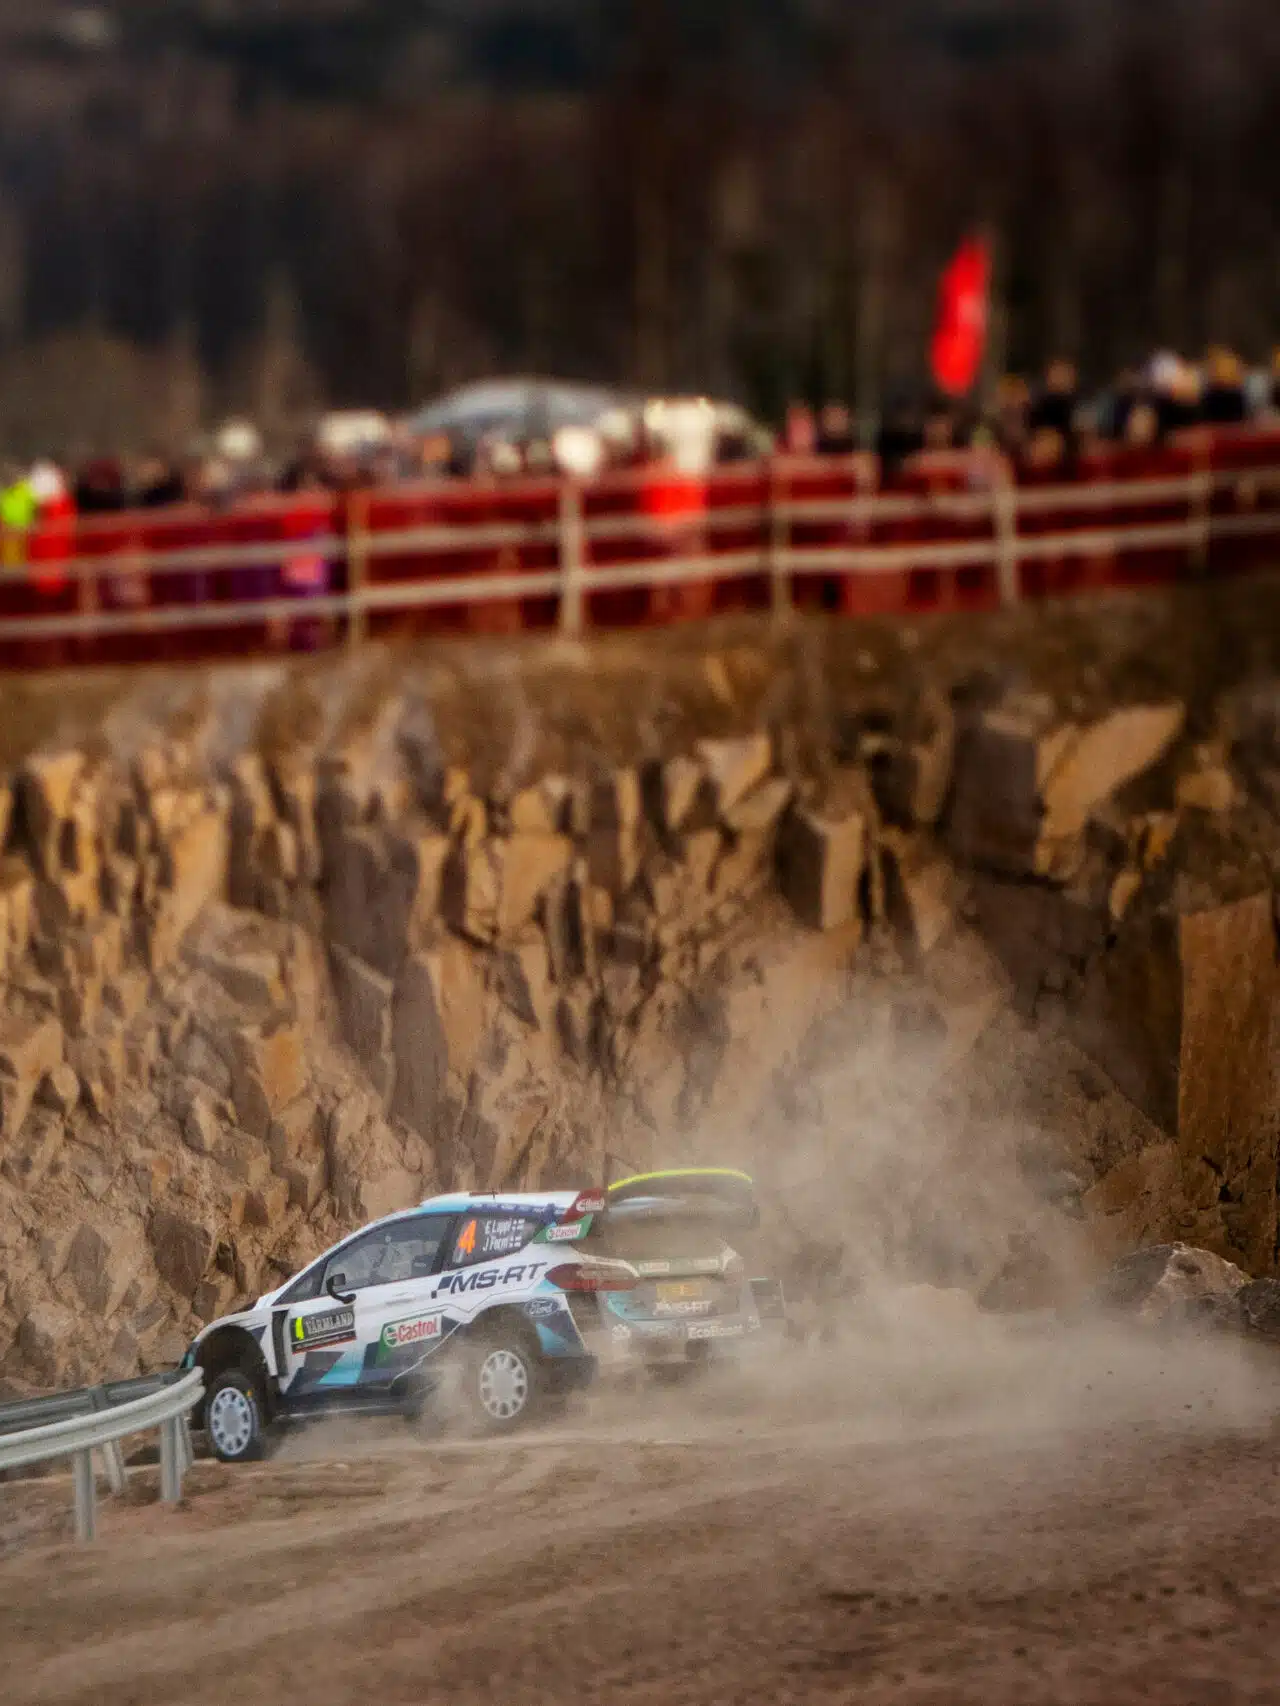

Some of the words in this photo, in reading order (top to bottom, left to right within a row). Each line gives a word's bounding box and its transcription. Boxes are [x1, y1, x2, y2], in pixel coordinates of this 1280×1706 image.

[458, 1219, 477, 1254] 4
[449, 1262, 548, 1294] MS-RT
[398, 1318, 438, 1343] Castrol
